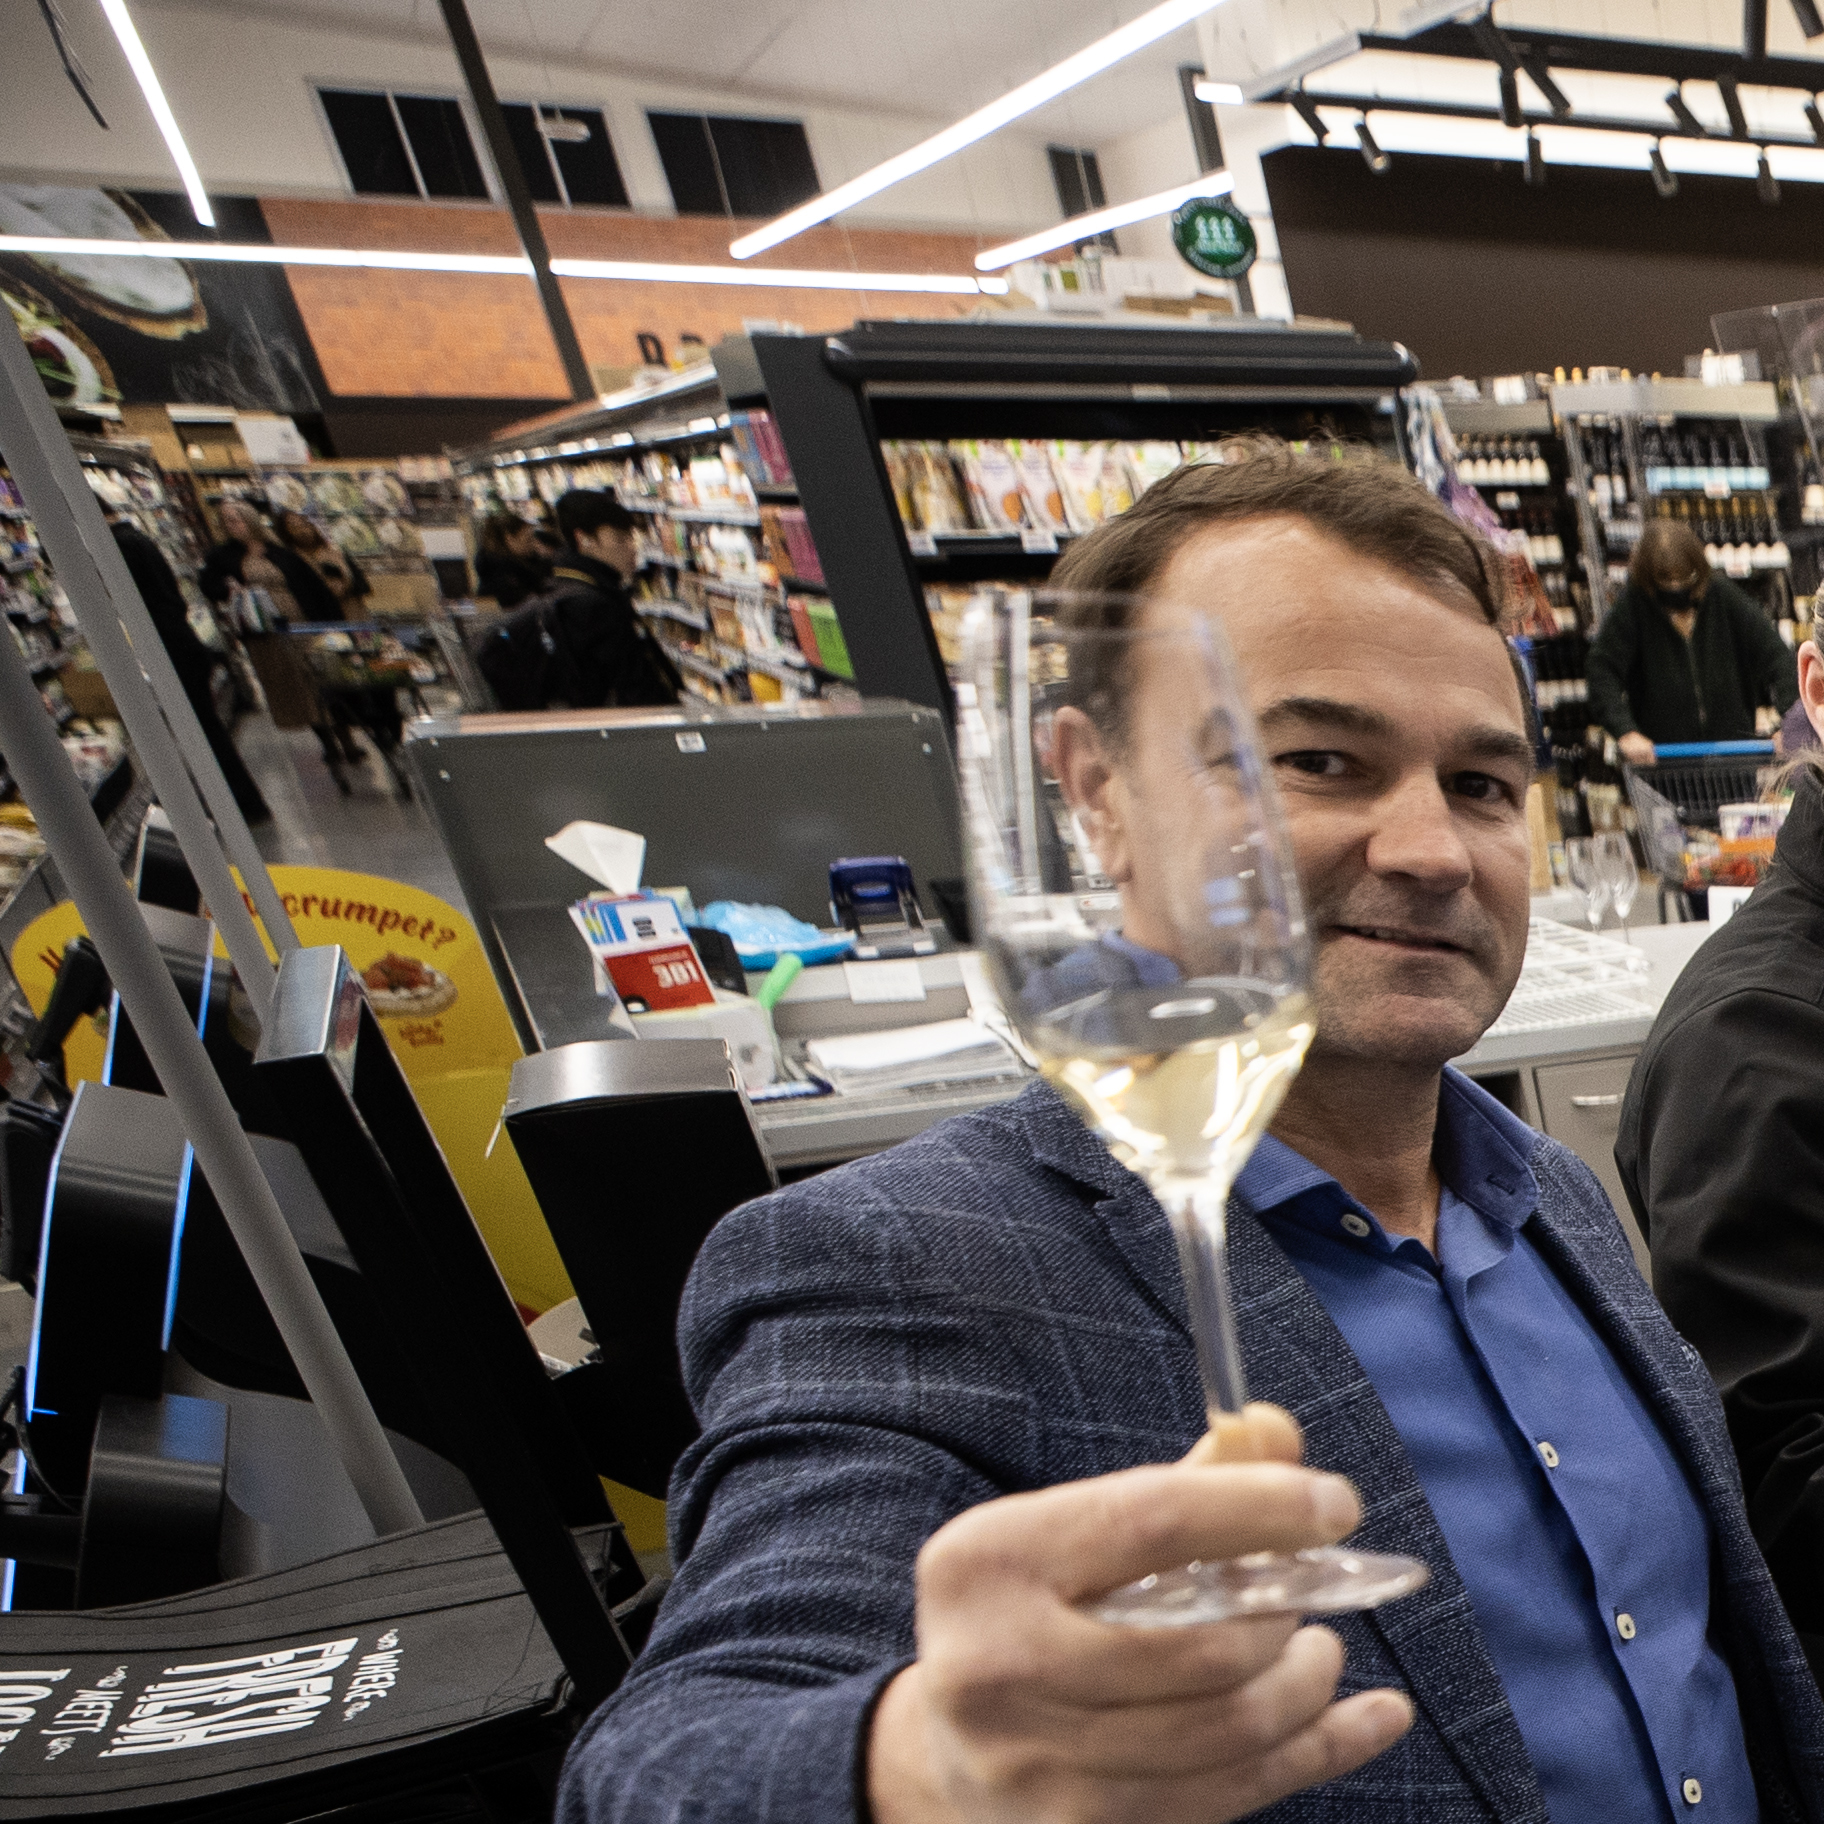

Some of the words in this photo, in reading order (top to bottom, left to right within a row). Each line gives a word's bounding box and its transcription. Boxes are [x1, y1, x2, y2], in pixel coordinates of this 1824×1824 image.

[281, 892, 458, 950] crumpet?
[98, 1636, 359, 1759] FRESH
[343, 1648, 404, 1703] WHERE
